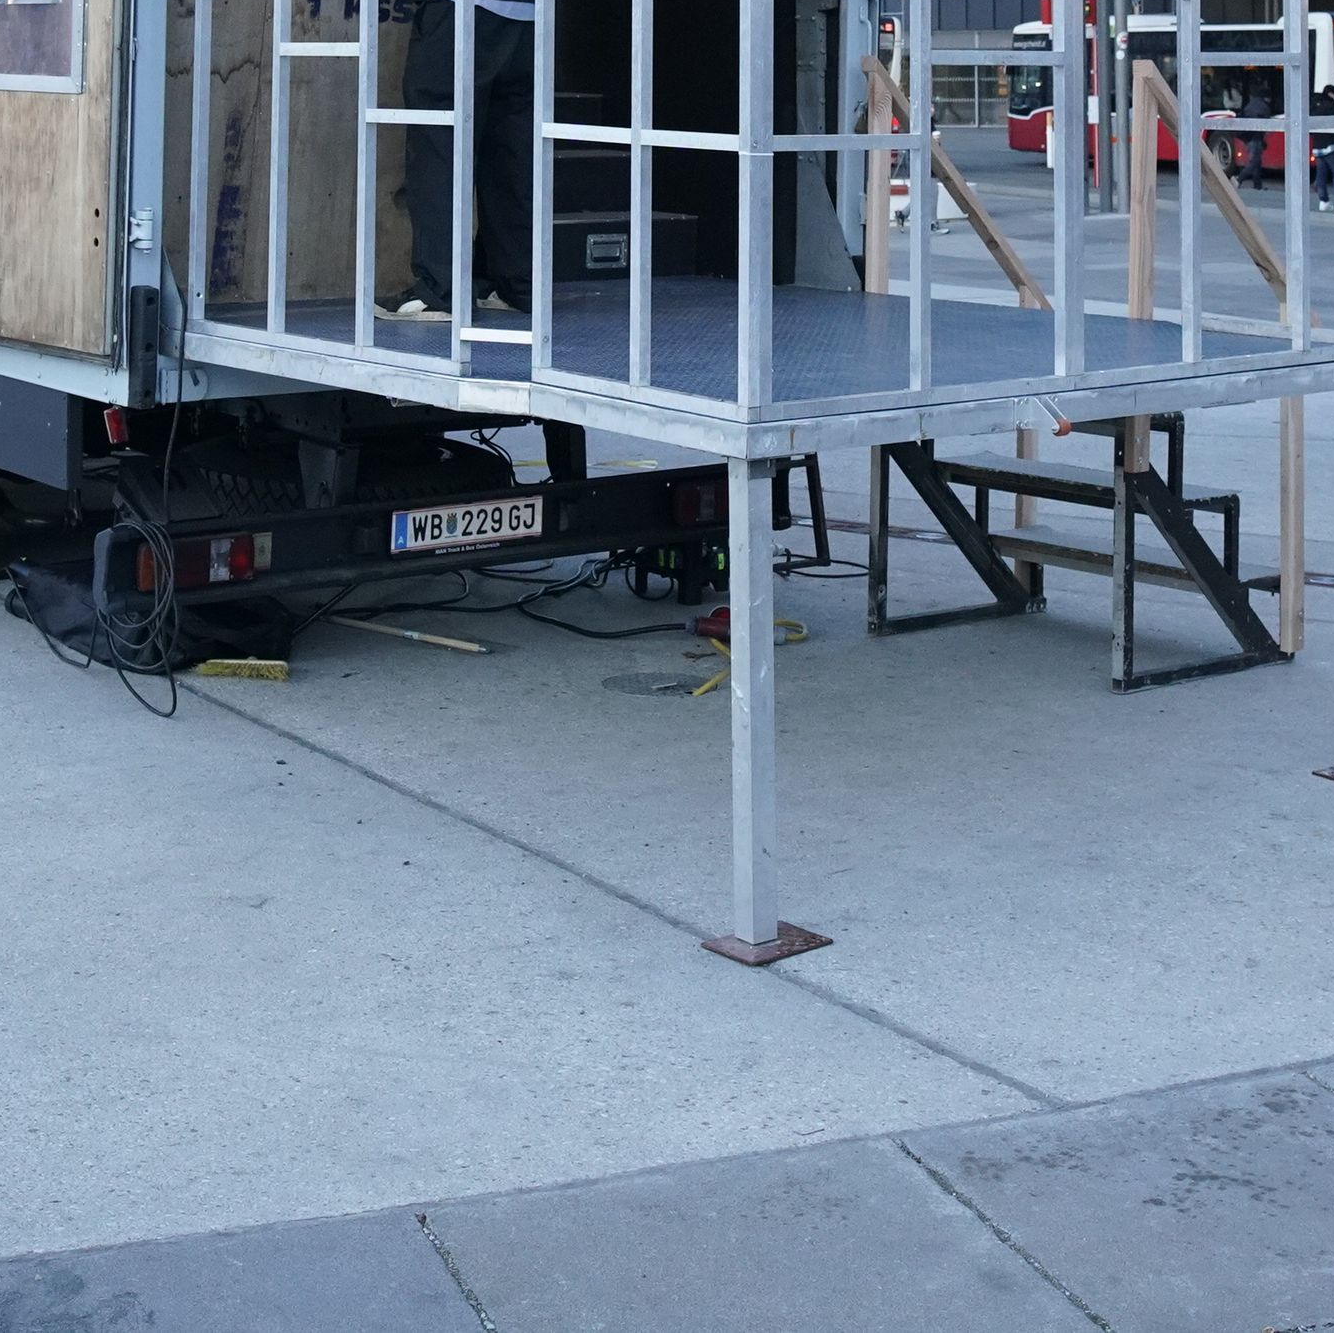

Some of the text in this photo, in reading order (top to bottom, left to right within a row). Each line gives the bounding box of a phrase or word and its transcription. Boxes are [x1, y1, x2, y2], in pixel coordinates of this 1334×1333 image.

[412, 503, 536, 543] WB 229 GJ
[397, 535, 405, 545] A
